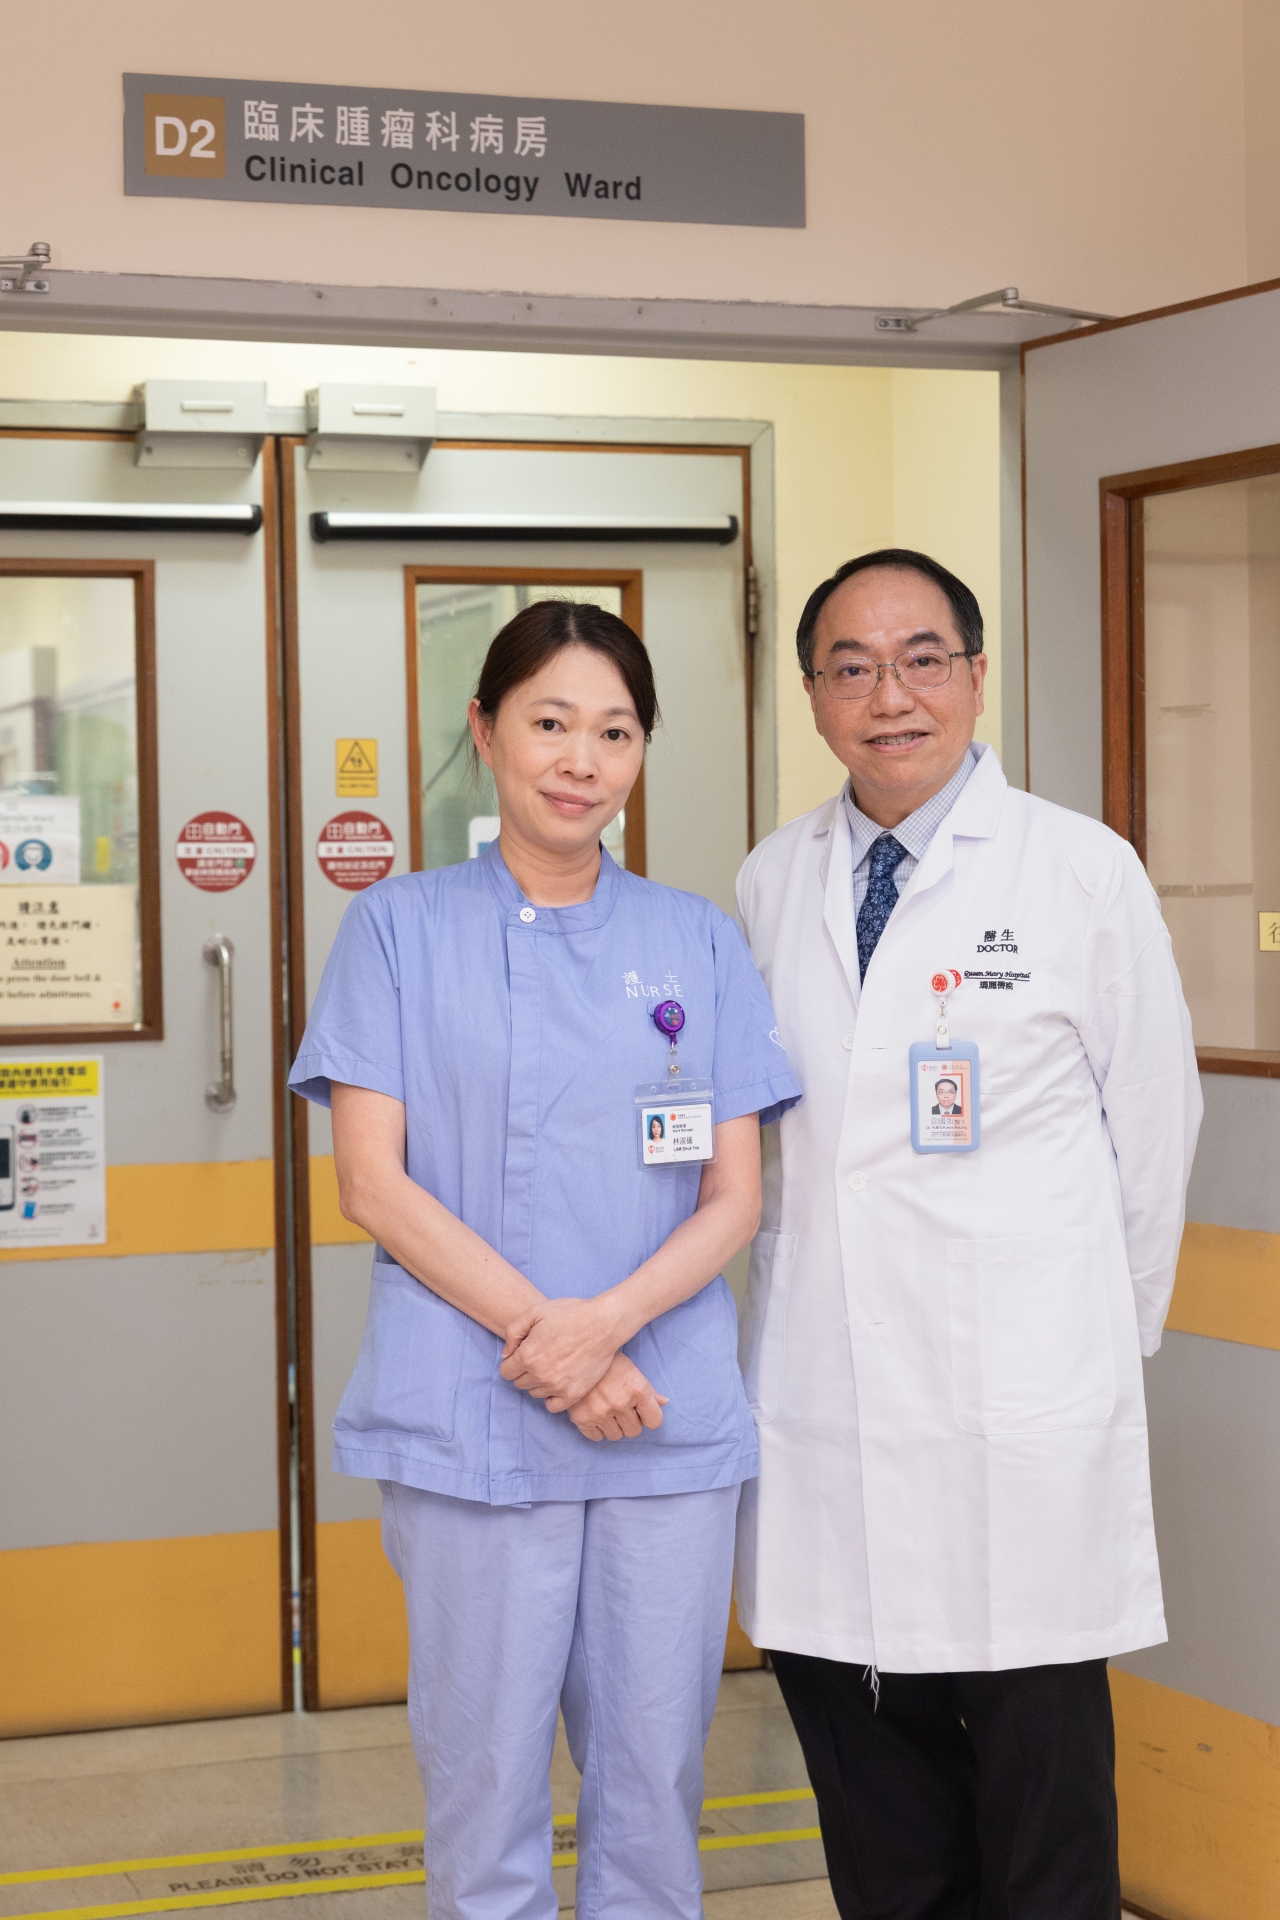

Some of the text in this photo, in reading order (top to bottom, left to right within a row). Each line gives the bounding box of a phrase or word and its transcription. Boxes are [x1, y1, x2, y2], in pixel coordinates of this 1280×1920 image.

[243, 99, 549, 158] 臨床腫瘤科病房
[154, 115, 216, 159] D2
[244, 154, 642, 203] Clinical Oncology Ward
[202, 822, 242, 836] 自動門
[343, 821, 381, 835] 自動門
[205, 847, 247, 855] CAUTION
[347, 845, 387, 854] CAUTION
[984, 928, 1015, 943] 醫生
[976, 943, 1019, 955] DOCTOR
[963, 970, 1032, 980] Queen Mary Hospital
[625, 983, 684, 999] NURSE
[168, 1874, 258, 1893] PLEASE
[264, 1869, 299, 1883] DO
[304, 1864, 351, 1878] NOT
[355, 1856, 412, 1873] STAY
